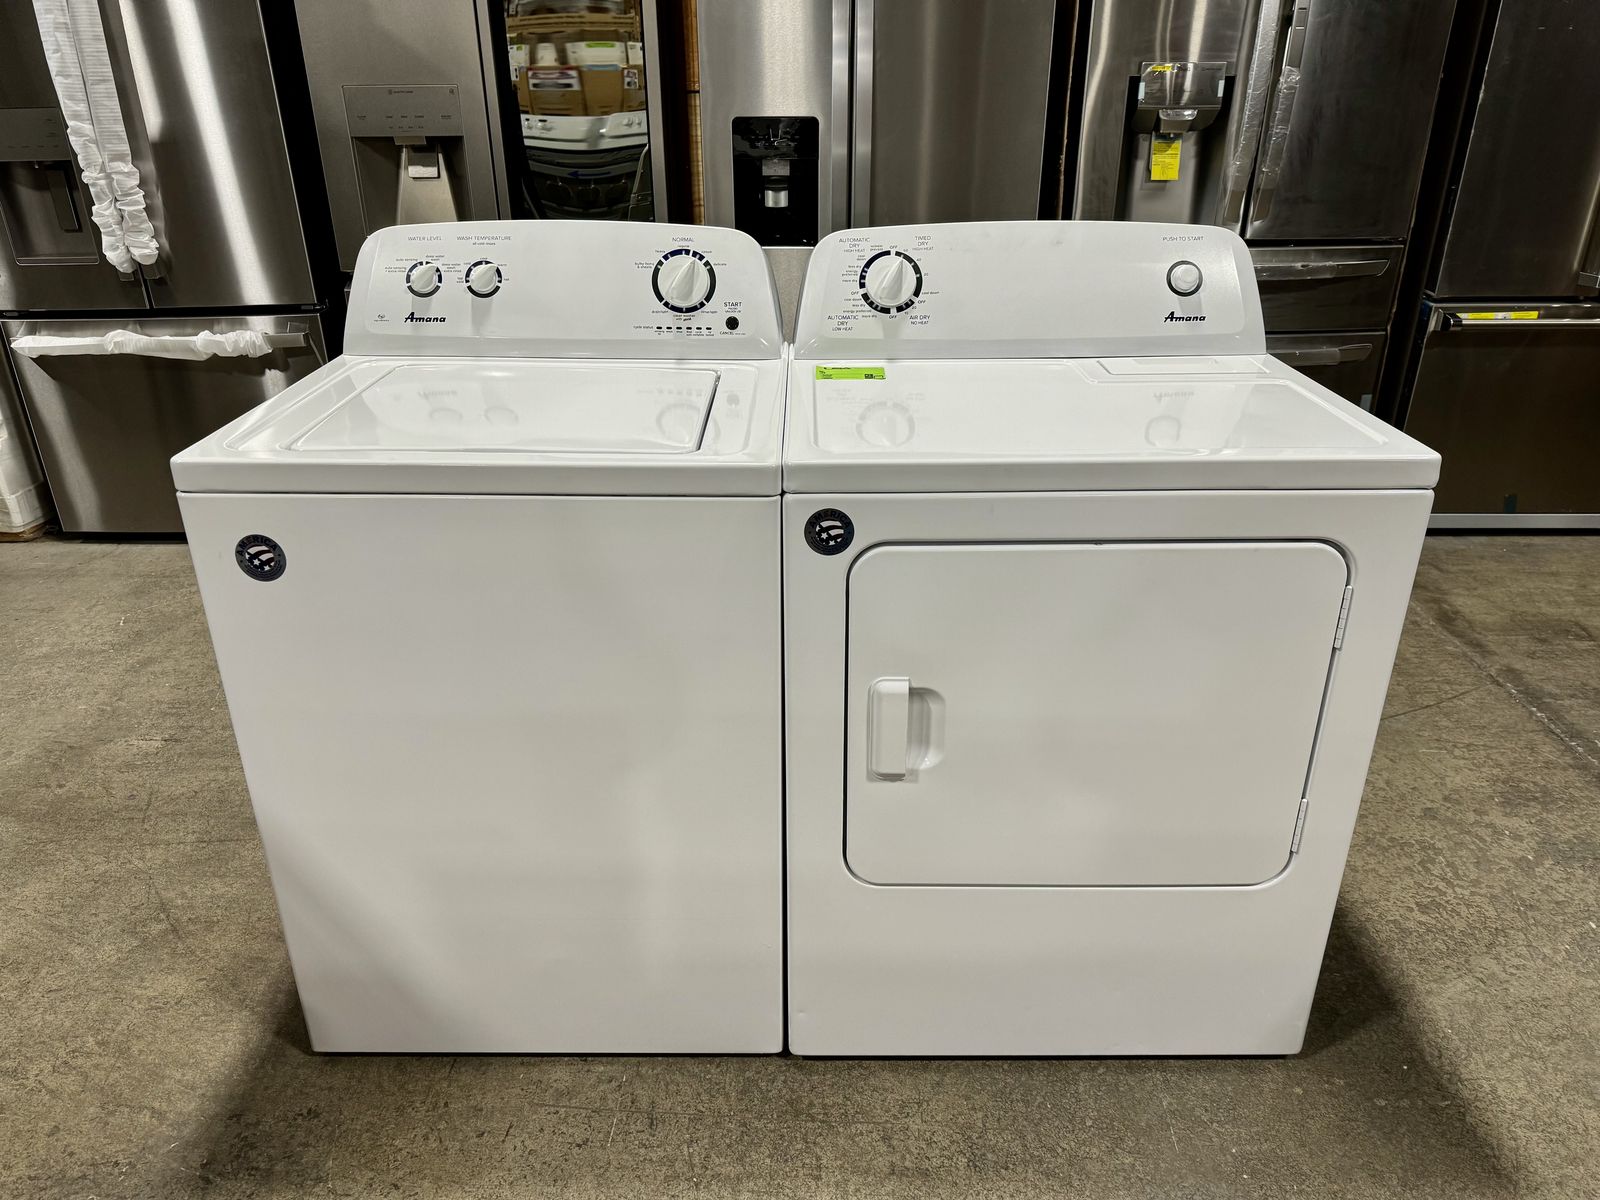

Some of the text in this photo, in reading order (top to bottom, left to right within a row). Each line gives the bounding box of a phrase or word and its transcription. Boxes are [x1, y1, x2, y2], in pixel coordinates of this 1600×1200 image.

[404, 312, 446, 323] Amana
[1164, 311, 1206, 322] Amana
[809, 511, 851, 528] AMERICA
[236, 535, 277, 556] AMERICA
